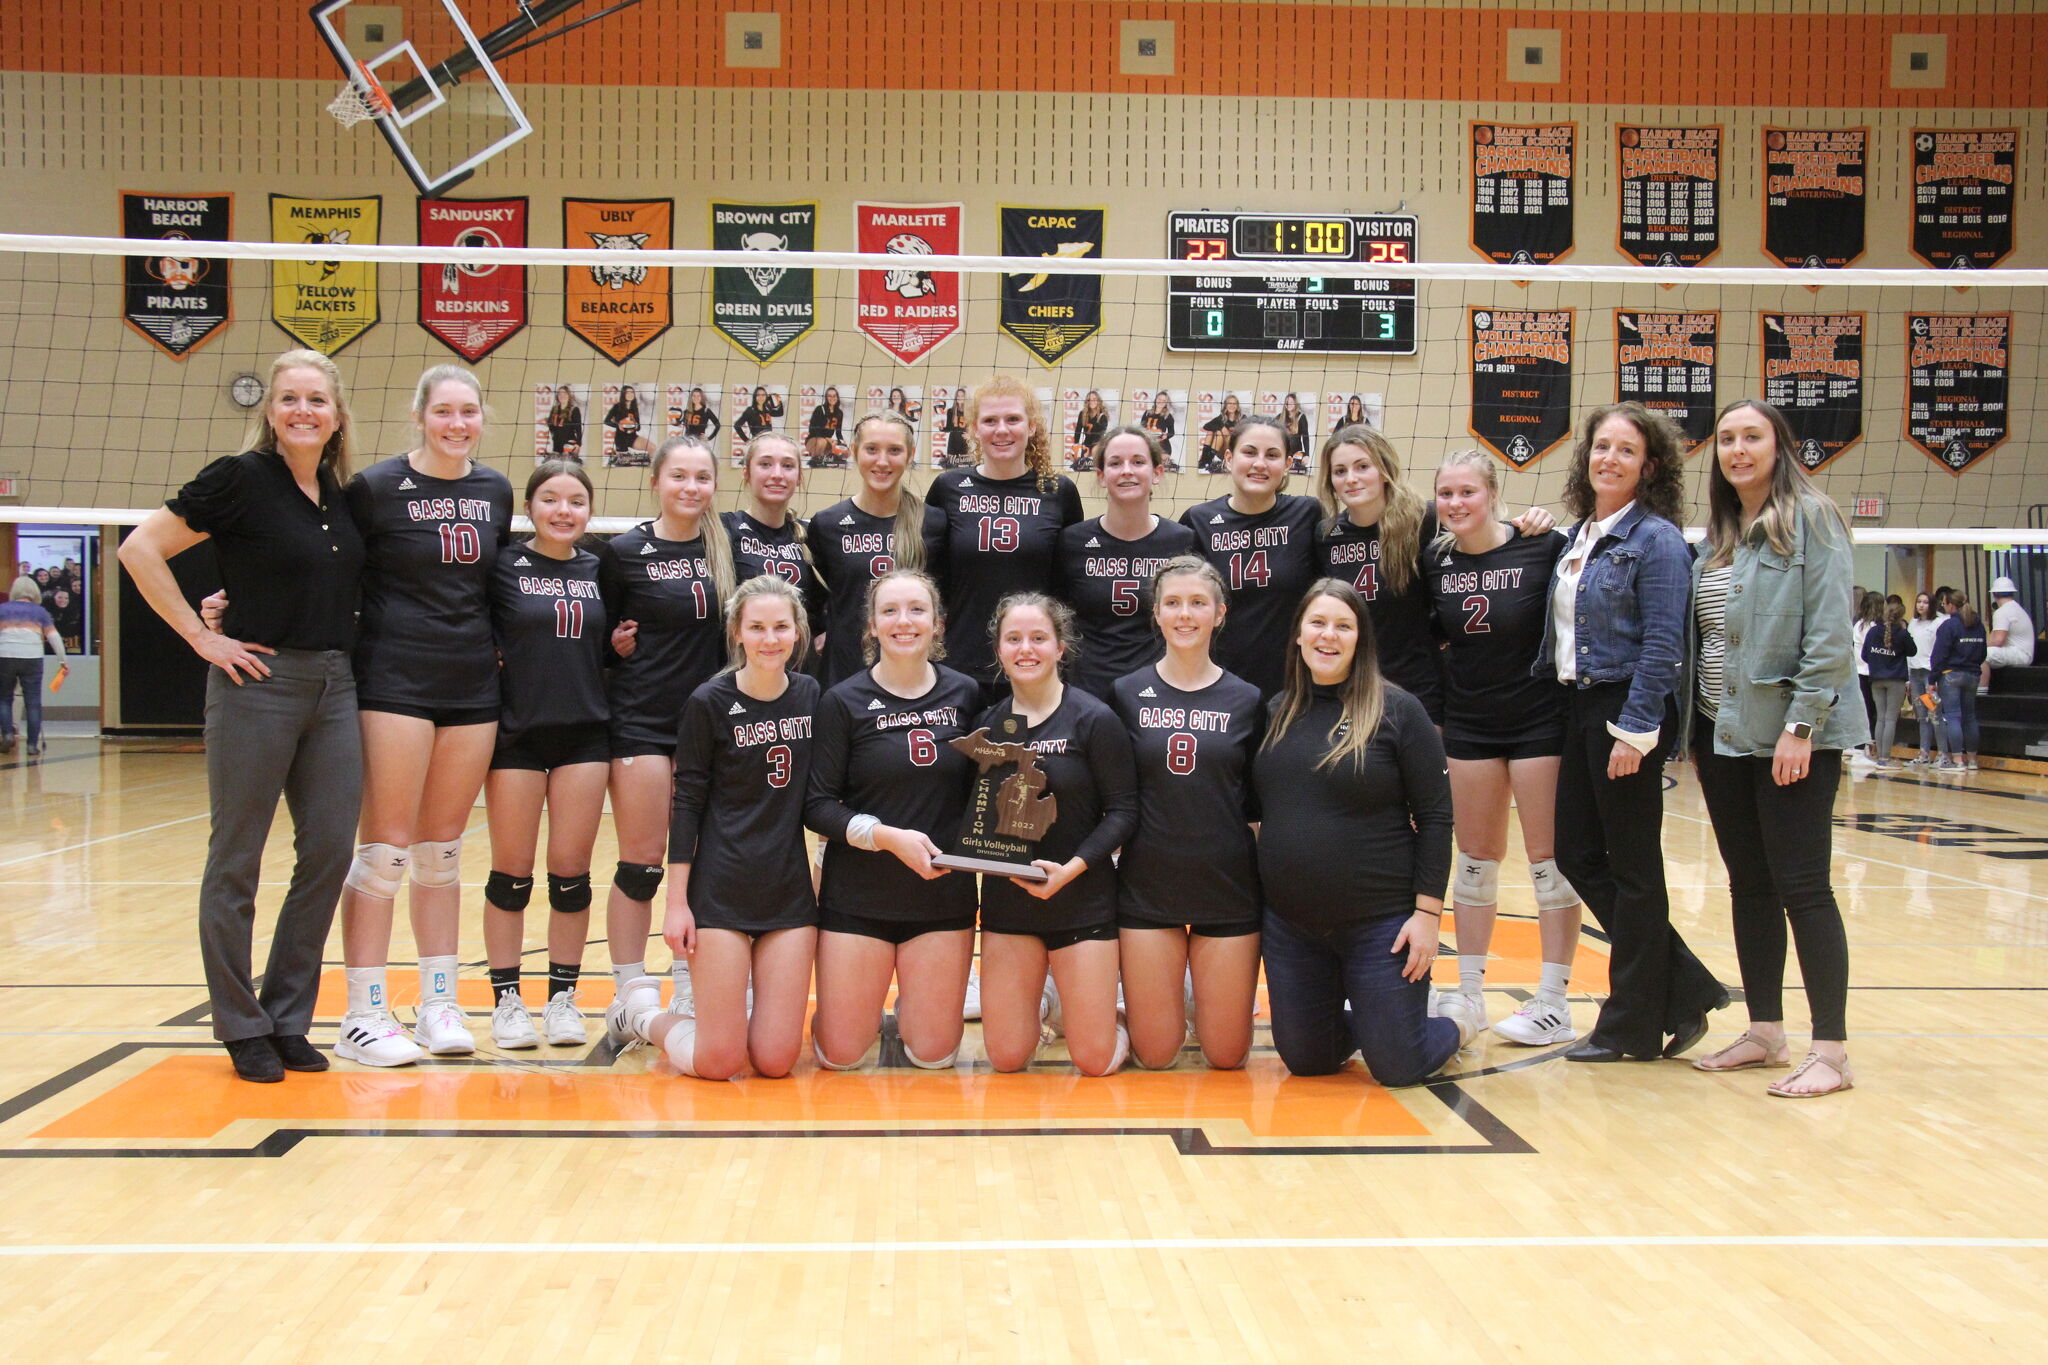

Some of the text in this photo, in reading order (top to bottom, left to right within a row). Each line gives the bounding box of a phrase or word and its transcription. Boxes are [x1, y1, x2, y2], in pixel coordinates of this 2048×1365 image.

[1476, 145, 1569, 159] BASKETBALL
[1623, 148, 1716, 161] BASKETBALL
[1769, 151, 1862, 164] BASKETBALL
[1934, 152, 1995, 165] SOCCER
[1476, 158, 1570, 178] CHAMPIONS
[1623, 160, 1716, 180] CHAMPIONS
[1793, 164, 1837, 176] STATE
[1917, 164, 2012, 184] CHAMPIONS
[1769, 175, 1862, 195] CHAMPIONS
[144, 199, 208, 212] HARBOR
[290, 207, 361, 218] MEMPHIS
[152, 213, 202, 226] BEACH
[430, 208, 514, 221] SANDUSKY
[600, 210, 635, 222] UBLY
[716, 211, 811, 225] BROWN CITY
[871, 213, 947, 227] MARLETTE
[1027, 215, 1077, 229] CAPAC
[1175, 218, 1230, 234] PIRATES
[1356, 222, 1413, 237] VISITOR
[1275, 222, 1344, 254] 1:00
[1187, 240, 1225, 260] 22
[1370, 243, 1408, 263] 25
[1196, 277, 1232, 289] BONUS
[1354, 280, 1390, 292] BONUS
[296, 285, 355, 298] YELLOW
[147, 296, 207, 310] PIRATES
[296, 300, 355, 312] JACKETS
[436, 300, 510, 313] REDSKINS
[581, 302, 654, 314] BEARCATS
[715, 302, 813, 317] GREEN DEVILS
[1190, 297, 1224, 308] FOULS
[1257, 298, 1339, 310] PLAYER FOULS
[1362, 300, 1395, 311] FOULS
[859, 304, 957, 318] RED RAIDERS
[1028, 305, 1074, 319] CHIEFS
[1206, 311, 1223, 336] 0
[1379, 313, 1394, 339] 3
[1277, 340, 1304, 350] GAME
[1476, 330, 1567, 344] VOLLEYBALL
[1641, 334, 1692, 346] TRACK
[1787, 335, 1838, 348] TRACK
[1914, 336, 2002, 350] X-COUNTRY
[1475, 342, 1569, 364] CHAMPIONS
[1620, 345, 1713, 365] CHAMPIONS
[1791, 348, 1834, 360] STATE
[1911, 349, 2006, 368] CHAMPIONS
[1767, 359, 1860, 379] CHAMPIONS
[1502, 390, 1539, 398] DISTRICT
[1500, 415, 1541, 424] REGIONAL
[408, 498, 491, 522] CASS CITY
[959, 495, 1041, 516] CASS CITY
[1858, 498, 1880, 516] EXIT
[978, 516, 1020, 553] 13
[1211, 525, 1289, 552] CASS CITY
[439, 523, 481, 563] 10
[842, 534, 886, 554] CASS
[1330, 542, 1368, 565] CASS
[646, 559, 693, 581] CASS
[1085, 557, 1128, 578] CASS
[1229, 550, 1271, 591] 14
[519, 576, 600, 600] CASS CITY
[1353, 563, 1378, 601] 4
[1441, 567, 1523, 594] CASS CITY
[692, 581, 707, 619] 1
[1111, 580, 1140, 616] 5
[554, 599, 583, 638] 11
[1462, 594, 1491, 635] 2
[923, 706, 958, 727] CITY
[1139, 707, 1230, 733] CASS CITY
[733, 715, 812, 748] CASS CITY
[907, 728, 938, 767] 6
[1166, 732, 1197, 775] 8
[766, 744, 792, 789] 3
[973, 778, 991, 835] CHAMPION
[1012, 821, 1034, 830] 2022
[962, 837, 1027, 853] Girls Volleyball
[977, 849, 1005, 857] DIVISION
